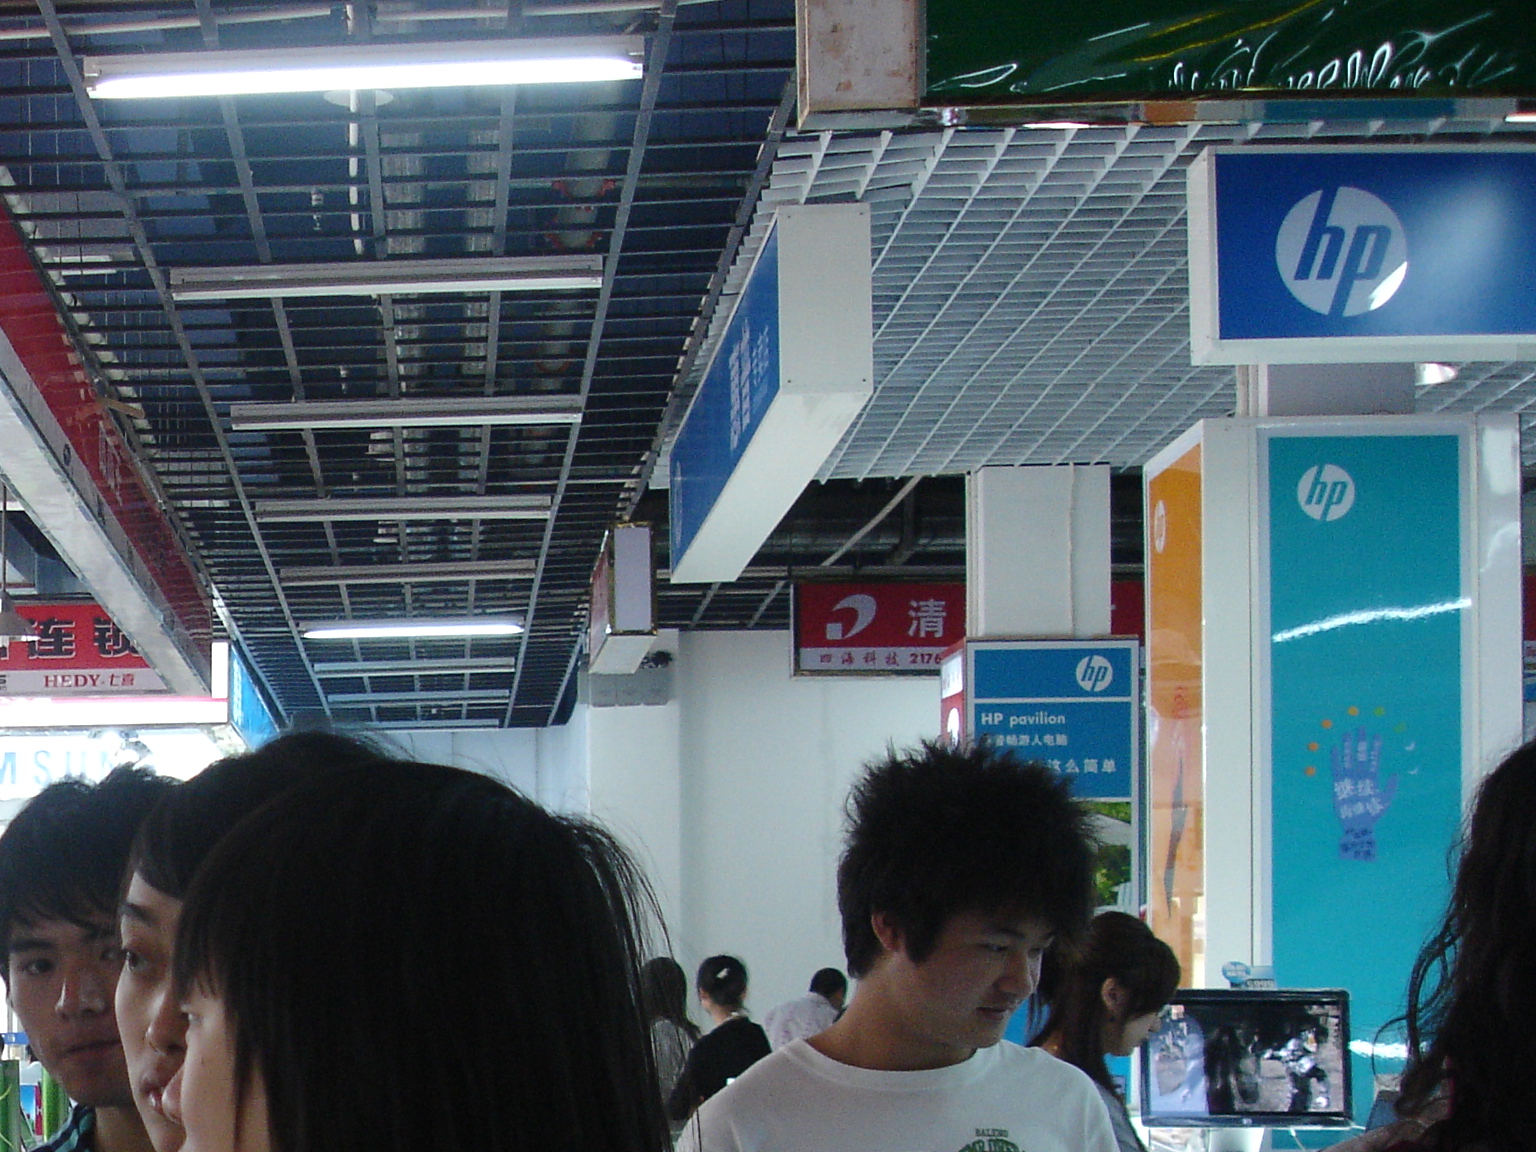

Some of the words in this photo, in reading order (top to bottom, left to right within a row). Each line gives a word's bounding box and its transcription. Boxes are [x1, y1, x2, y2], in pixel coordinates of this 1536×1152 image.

[1293, 186, 1400, 317] hp
[1297, 464, 1356, 522] hp
[907, 599, 947, 638] 清
[44, 673, 101, 688] HEDY
[1076, 654, 1114, 692] hp
[980, 712, 1005, 725] HP
[1009, 710, 1067, 728] pavilion
